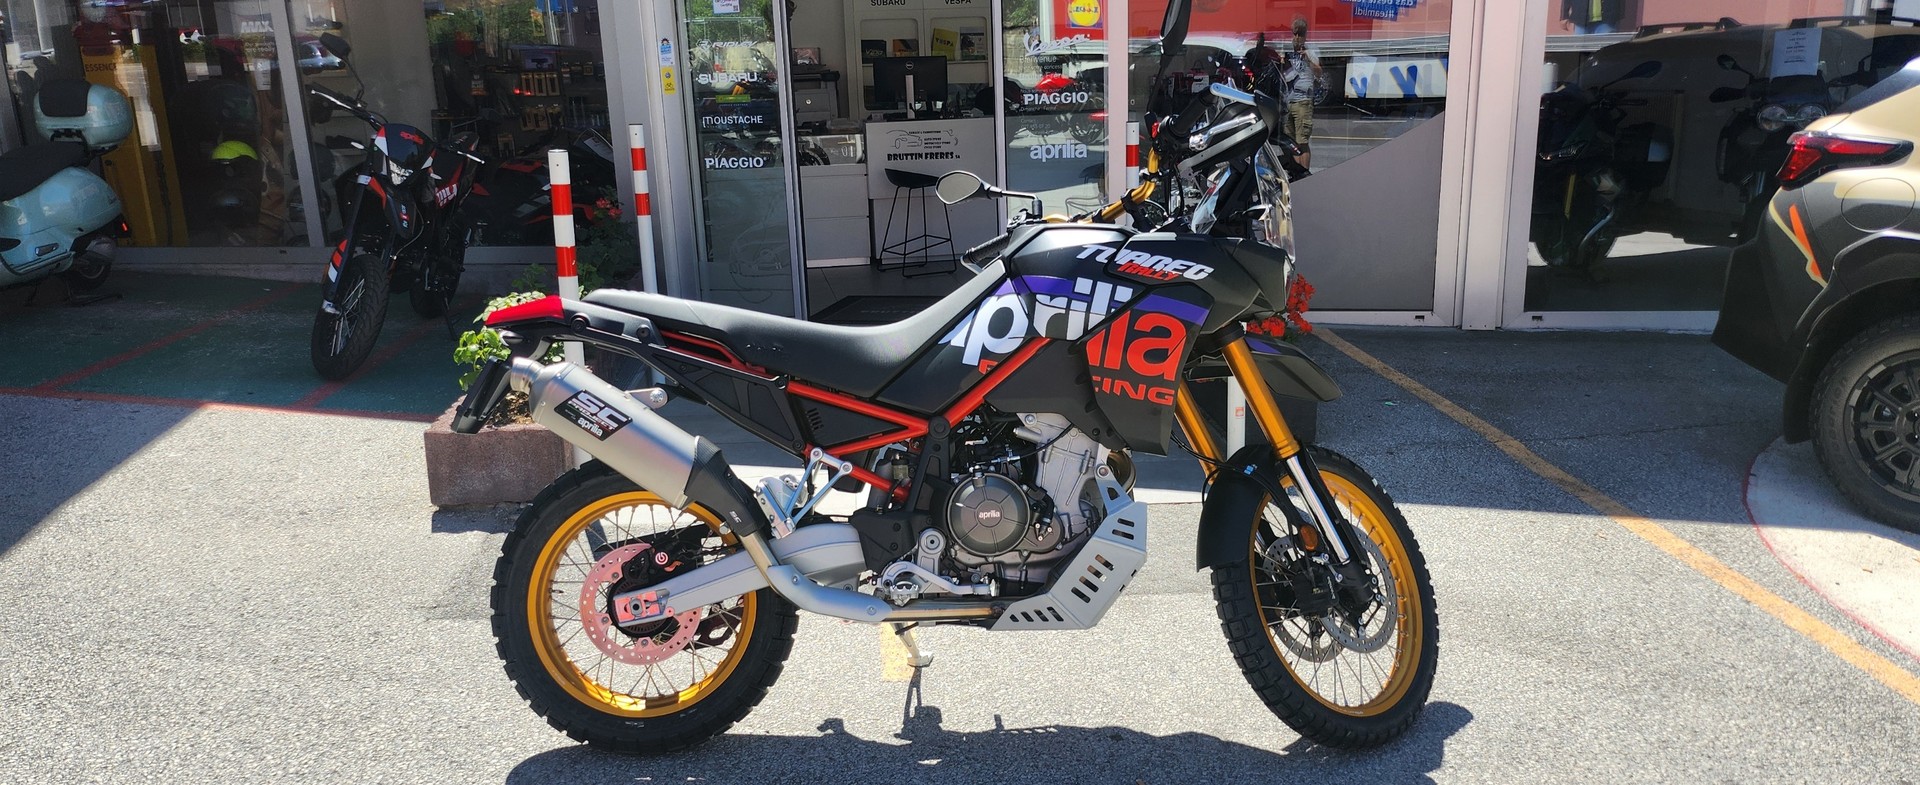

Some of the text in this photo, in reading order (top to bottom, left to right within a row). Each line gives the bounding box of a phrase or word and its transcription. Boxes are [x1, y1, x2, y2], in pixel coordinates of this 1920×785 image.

[712, 40, 758, 48] RIDLEY
[1023, 32, 1091, 57] Vespa
[697, 72, 758, 84] SUBARU
[1023, 91, 1088, 105] PIAGGIO
[887, 152, 923, 161] BRUTTIN
[925, 151, 954, 160] FRERES
[1029, 139, 1087, 162] aprilia
[704, 157, 764, 169] PIAGGIO
[1076, 244, 1215, 280] TUAREG
[1117, 262, 1180, 281] RALLY
[577, 391, 628, 428] SC
[577, 417, 603, 437] aprilia
[978, 509, 1000, 520] aprilia
